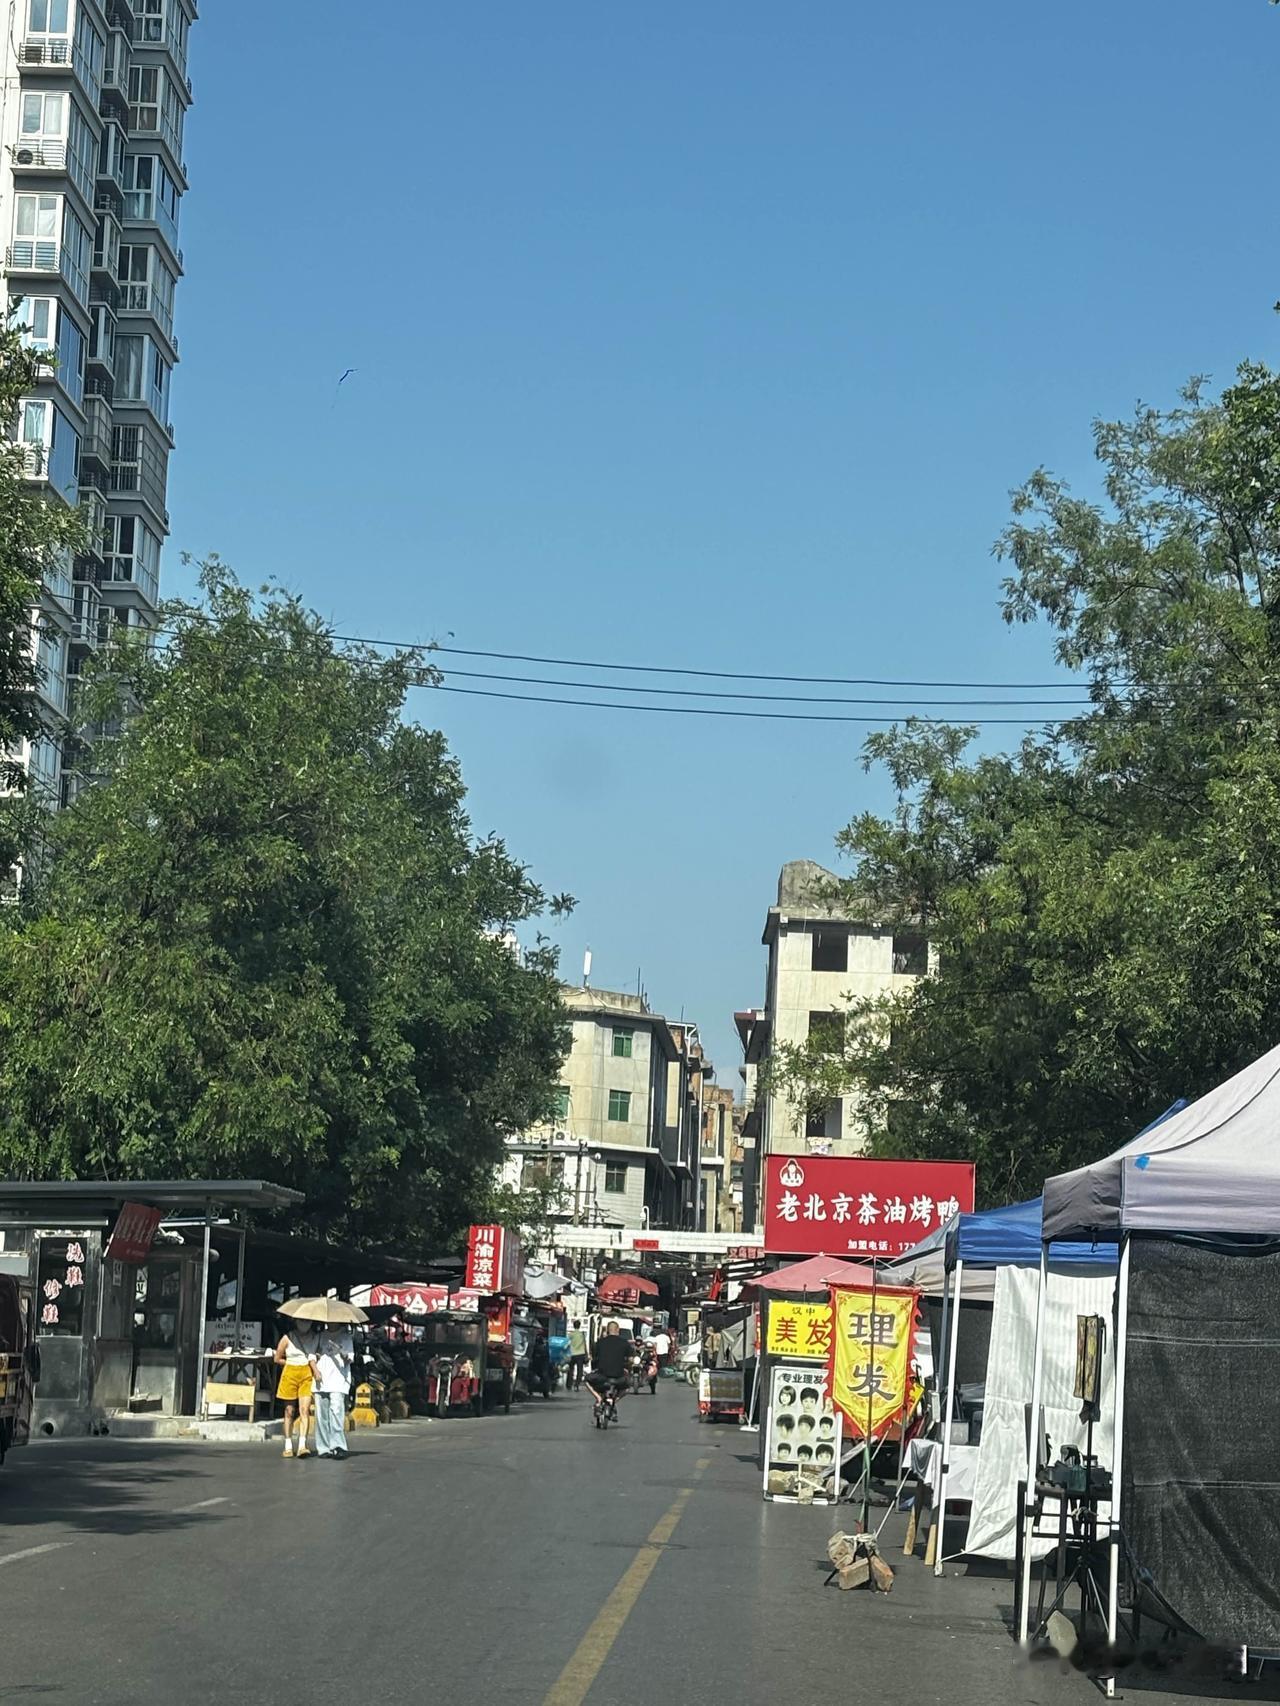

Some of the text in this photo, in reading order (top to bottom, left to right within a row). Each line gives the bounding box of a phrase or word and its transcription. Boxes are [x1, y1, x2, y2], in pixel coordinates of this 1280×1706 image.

[776, 1190, 960, 1228] 老北京茶油烤鸭
[64, 1242, 85, 1288] 洗鞋
[472, 1229, 494, 1287] 川渝凉菜
[41, 1279, 62, 1325] 修鞋
[792, 1306, 815, 1316] 汉中
[775, 1316, 829, 1346] 美发
[847, 1312, 899, 1401] 理发
[780, 1372, 824, 1385] 专业理发
